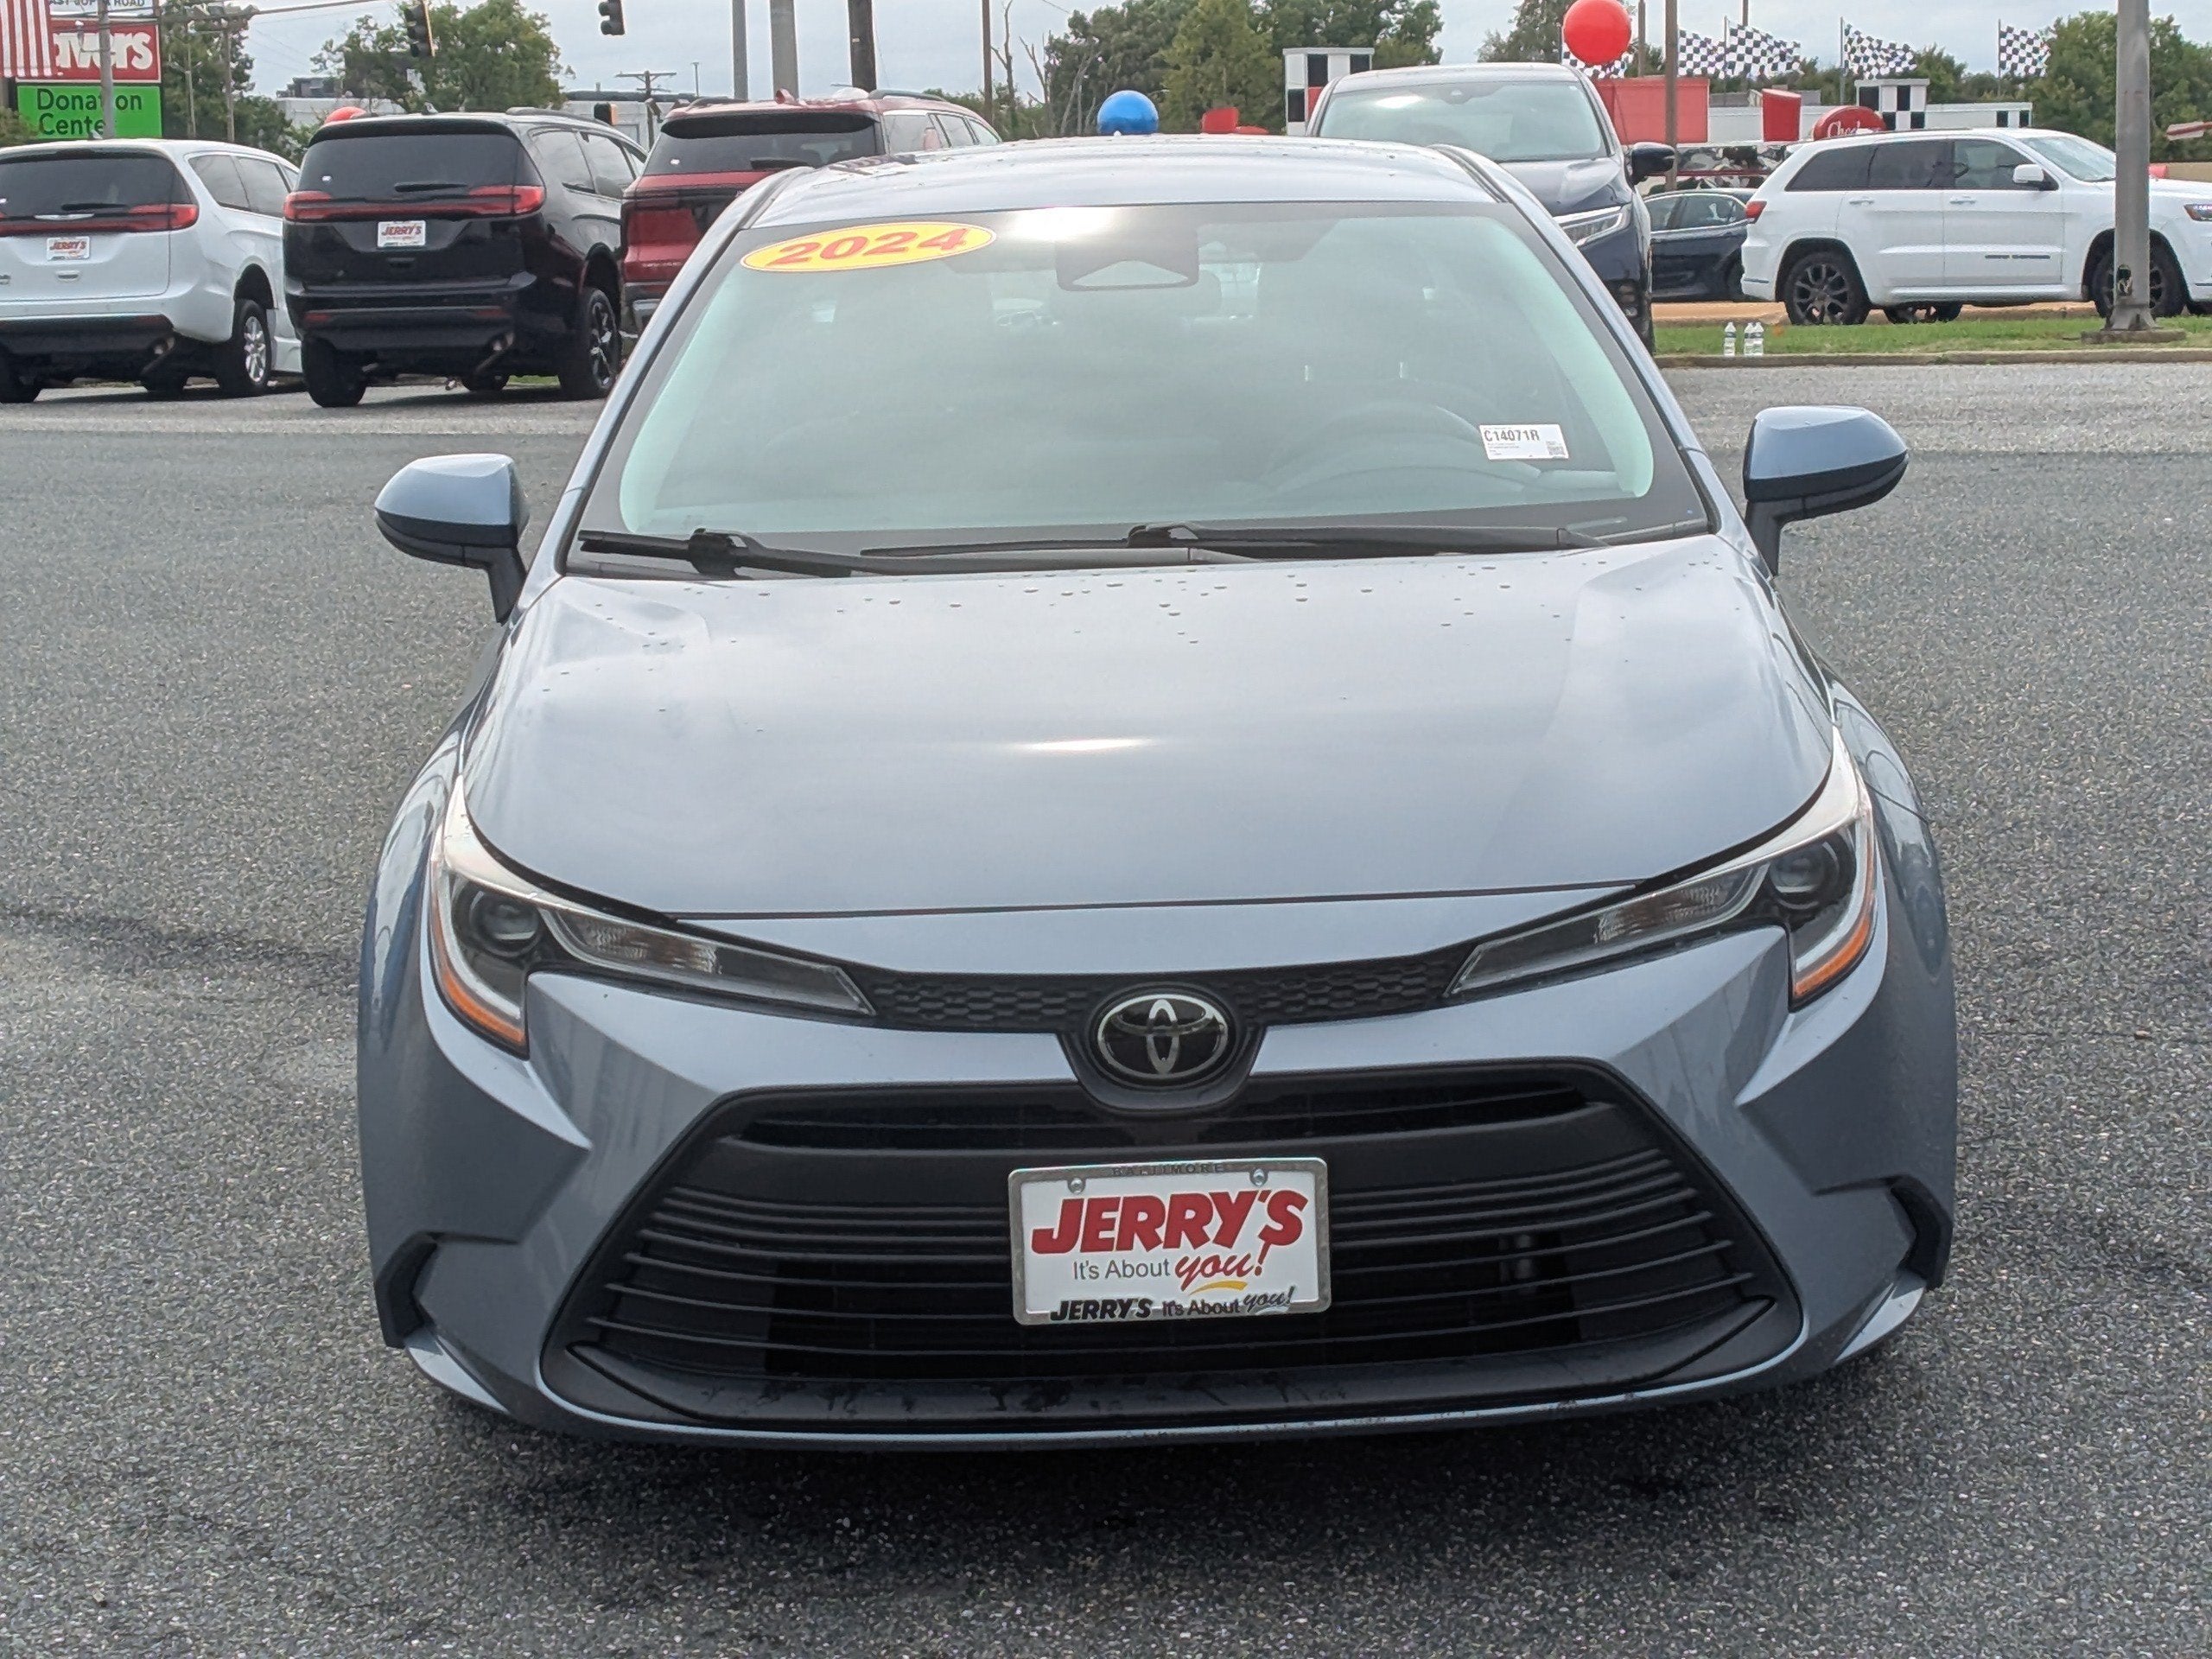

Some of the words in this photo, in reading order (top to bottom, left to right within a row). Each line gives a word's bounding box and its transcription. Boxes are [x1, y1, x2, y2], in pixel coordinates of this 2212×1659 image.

[37, 88, 142, 110] Donaon
[39, 113, 107, 135] Cente
[764, 228, 969, 268] 2024
[1031, 1189, 1309, 1255] JERRY'S
[1073, 1259, 1100, 1281] It's
[1105, 1258, 1171, 1280] About
[1174, 1241, 1271, 1293] you!
[1050, 1297, 1154, 1321] JERRY'S
[1162, 1300, 1184, 1317] It's
[1186, 1298, 1241, 1316] About
[1243, 1285, 1296, 1313] you!
